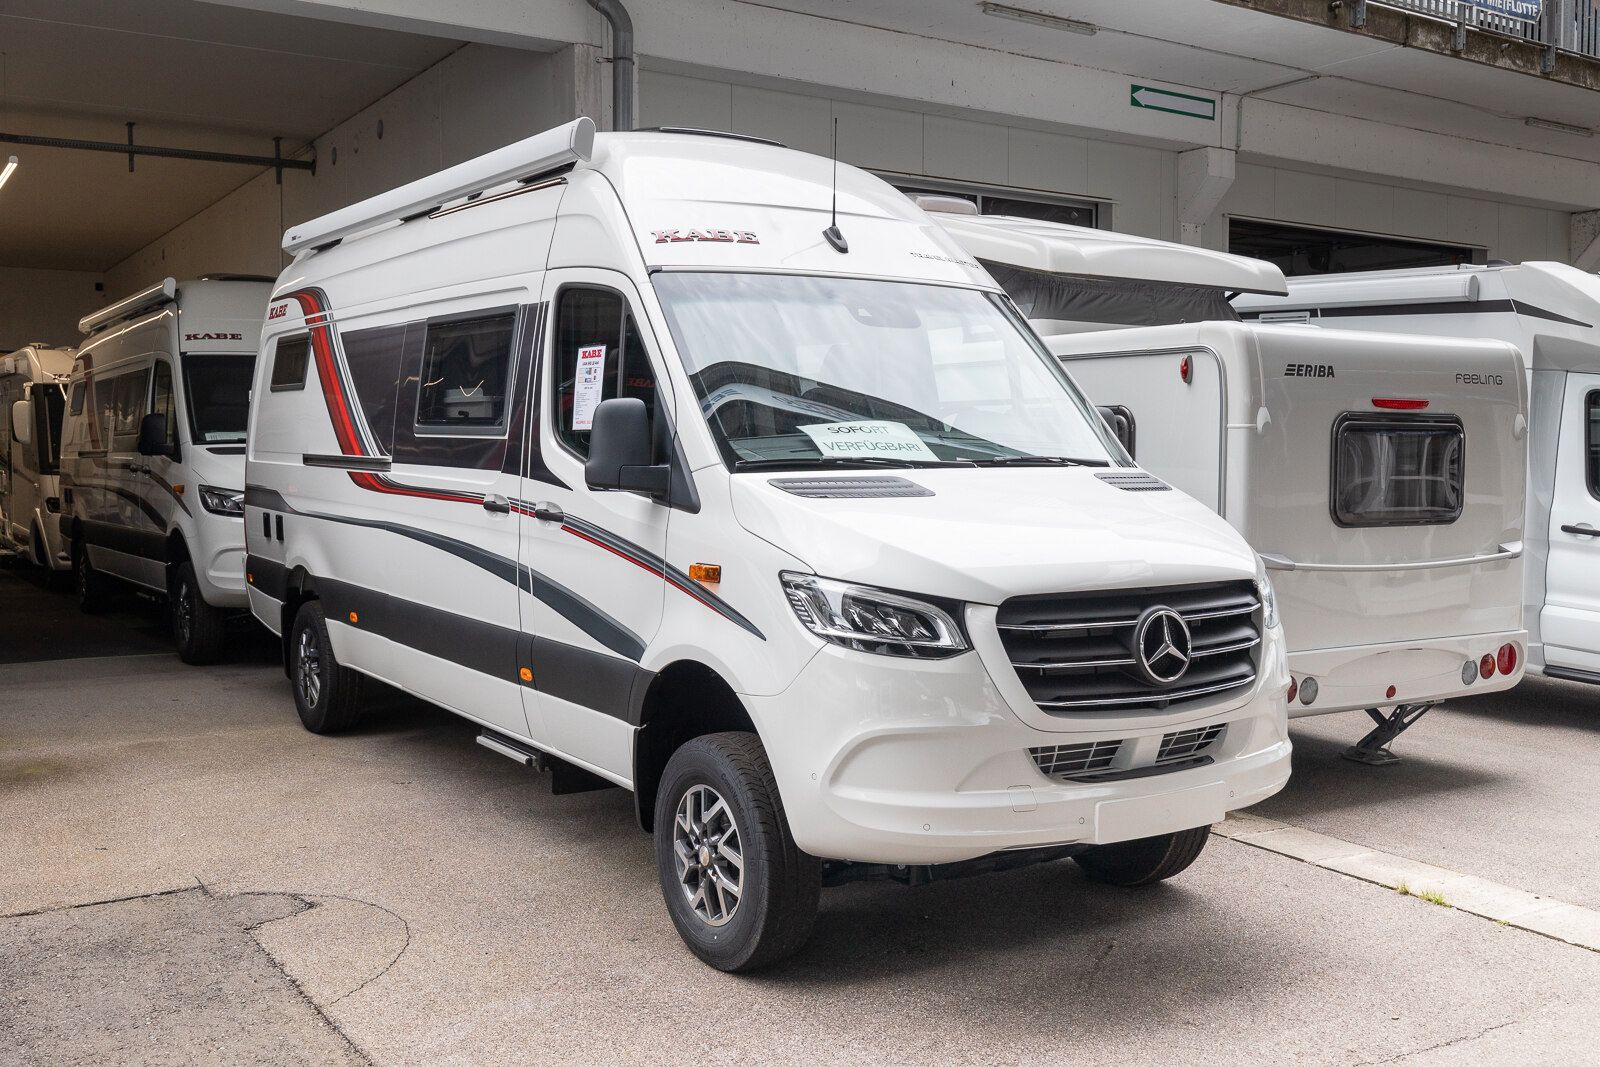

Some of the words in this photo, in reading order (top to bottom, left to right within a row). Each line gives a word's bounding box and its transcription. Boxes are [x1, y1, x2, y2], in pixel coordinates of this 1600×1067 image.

[651, 228, 760, 244] KABE
[268, 304, 288, 320] KABE
[185, 333, 242, 341] KABE
[581, 349, 602, 359] KABE
[1295, 364, 1335, 378] ERIBA
[827, 425, 889, 434] SOFORT
[823, 440, 922, 452] VERFÜGBAR!
